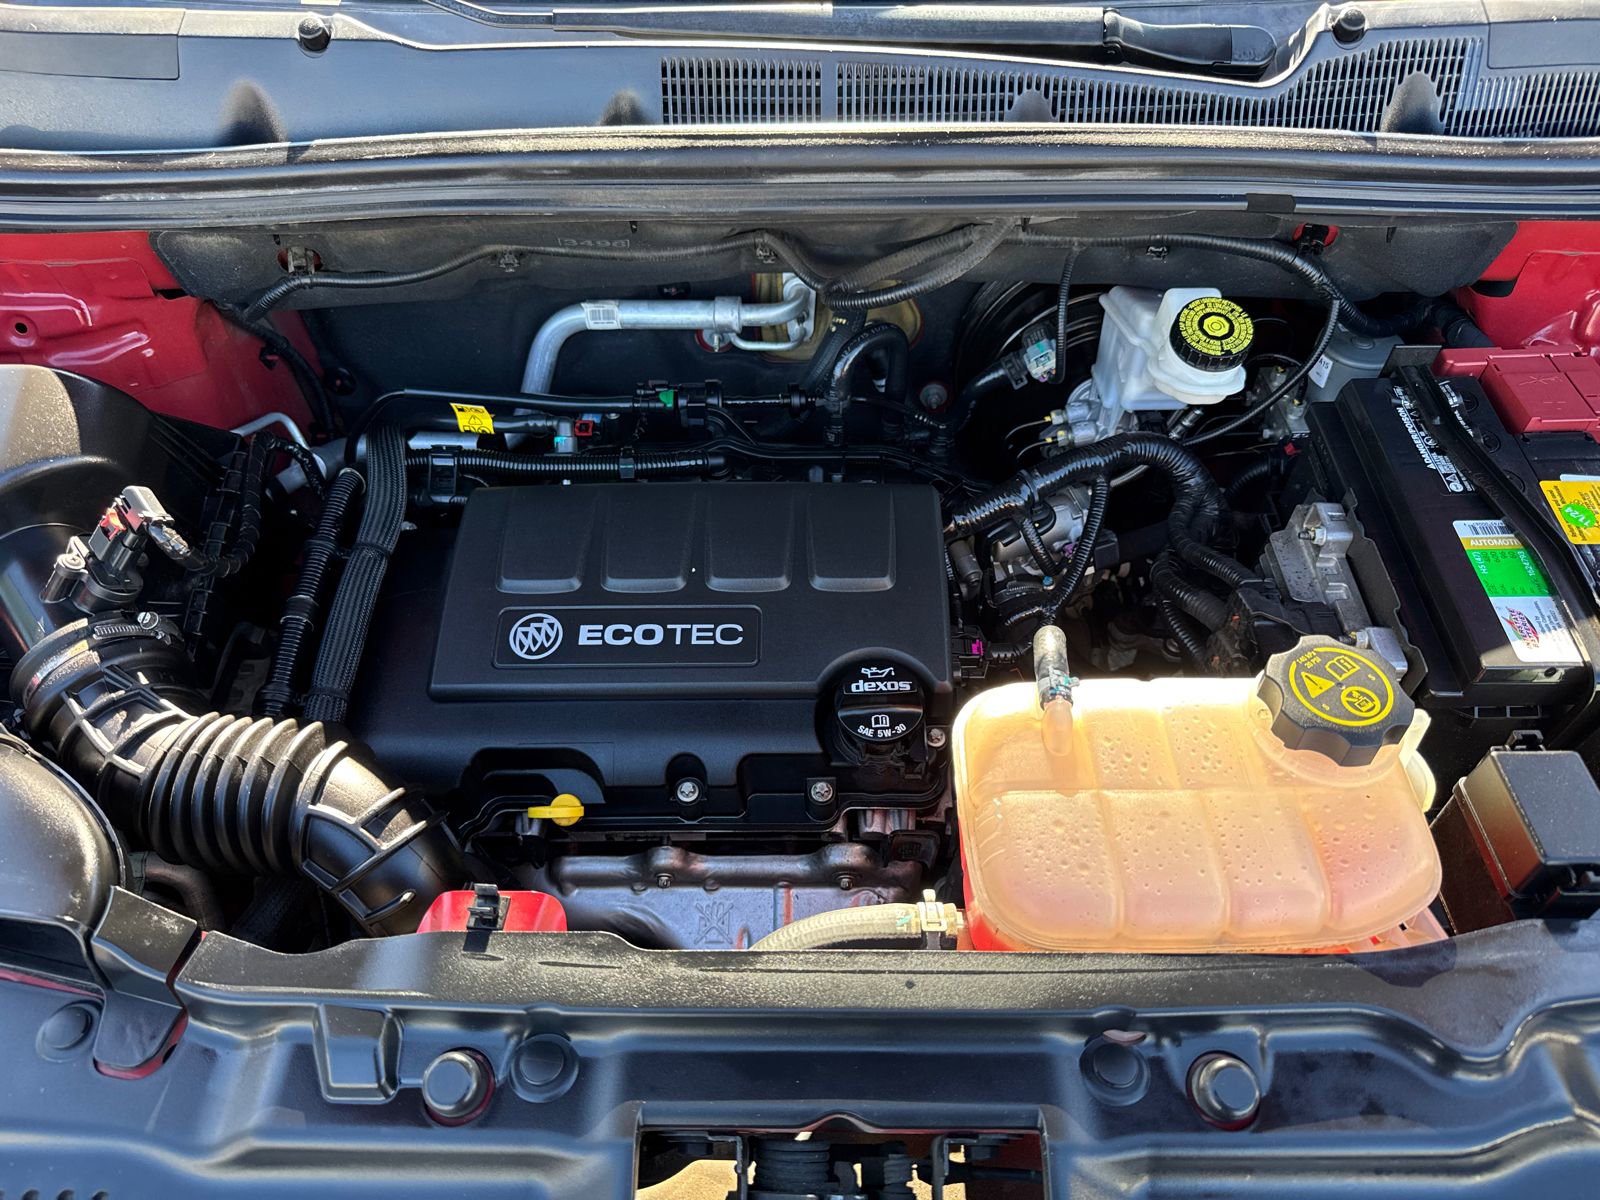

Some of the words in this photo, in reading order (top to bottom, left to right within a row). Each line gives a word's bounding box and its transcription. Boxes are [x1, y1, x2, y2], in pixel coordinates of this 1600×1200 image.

[1396, 407, 1433, 464] DANGER/POISON
[578, 623, 744, 646] ECOTEC
[850, 680, 912, 692] dexos
[857, 725, 874, 737] SAE
[877, 723, 907, 737] 5W-30
